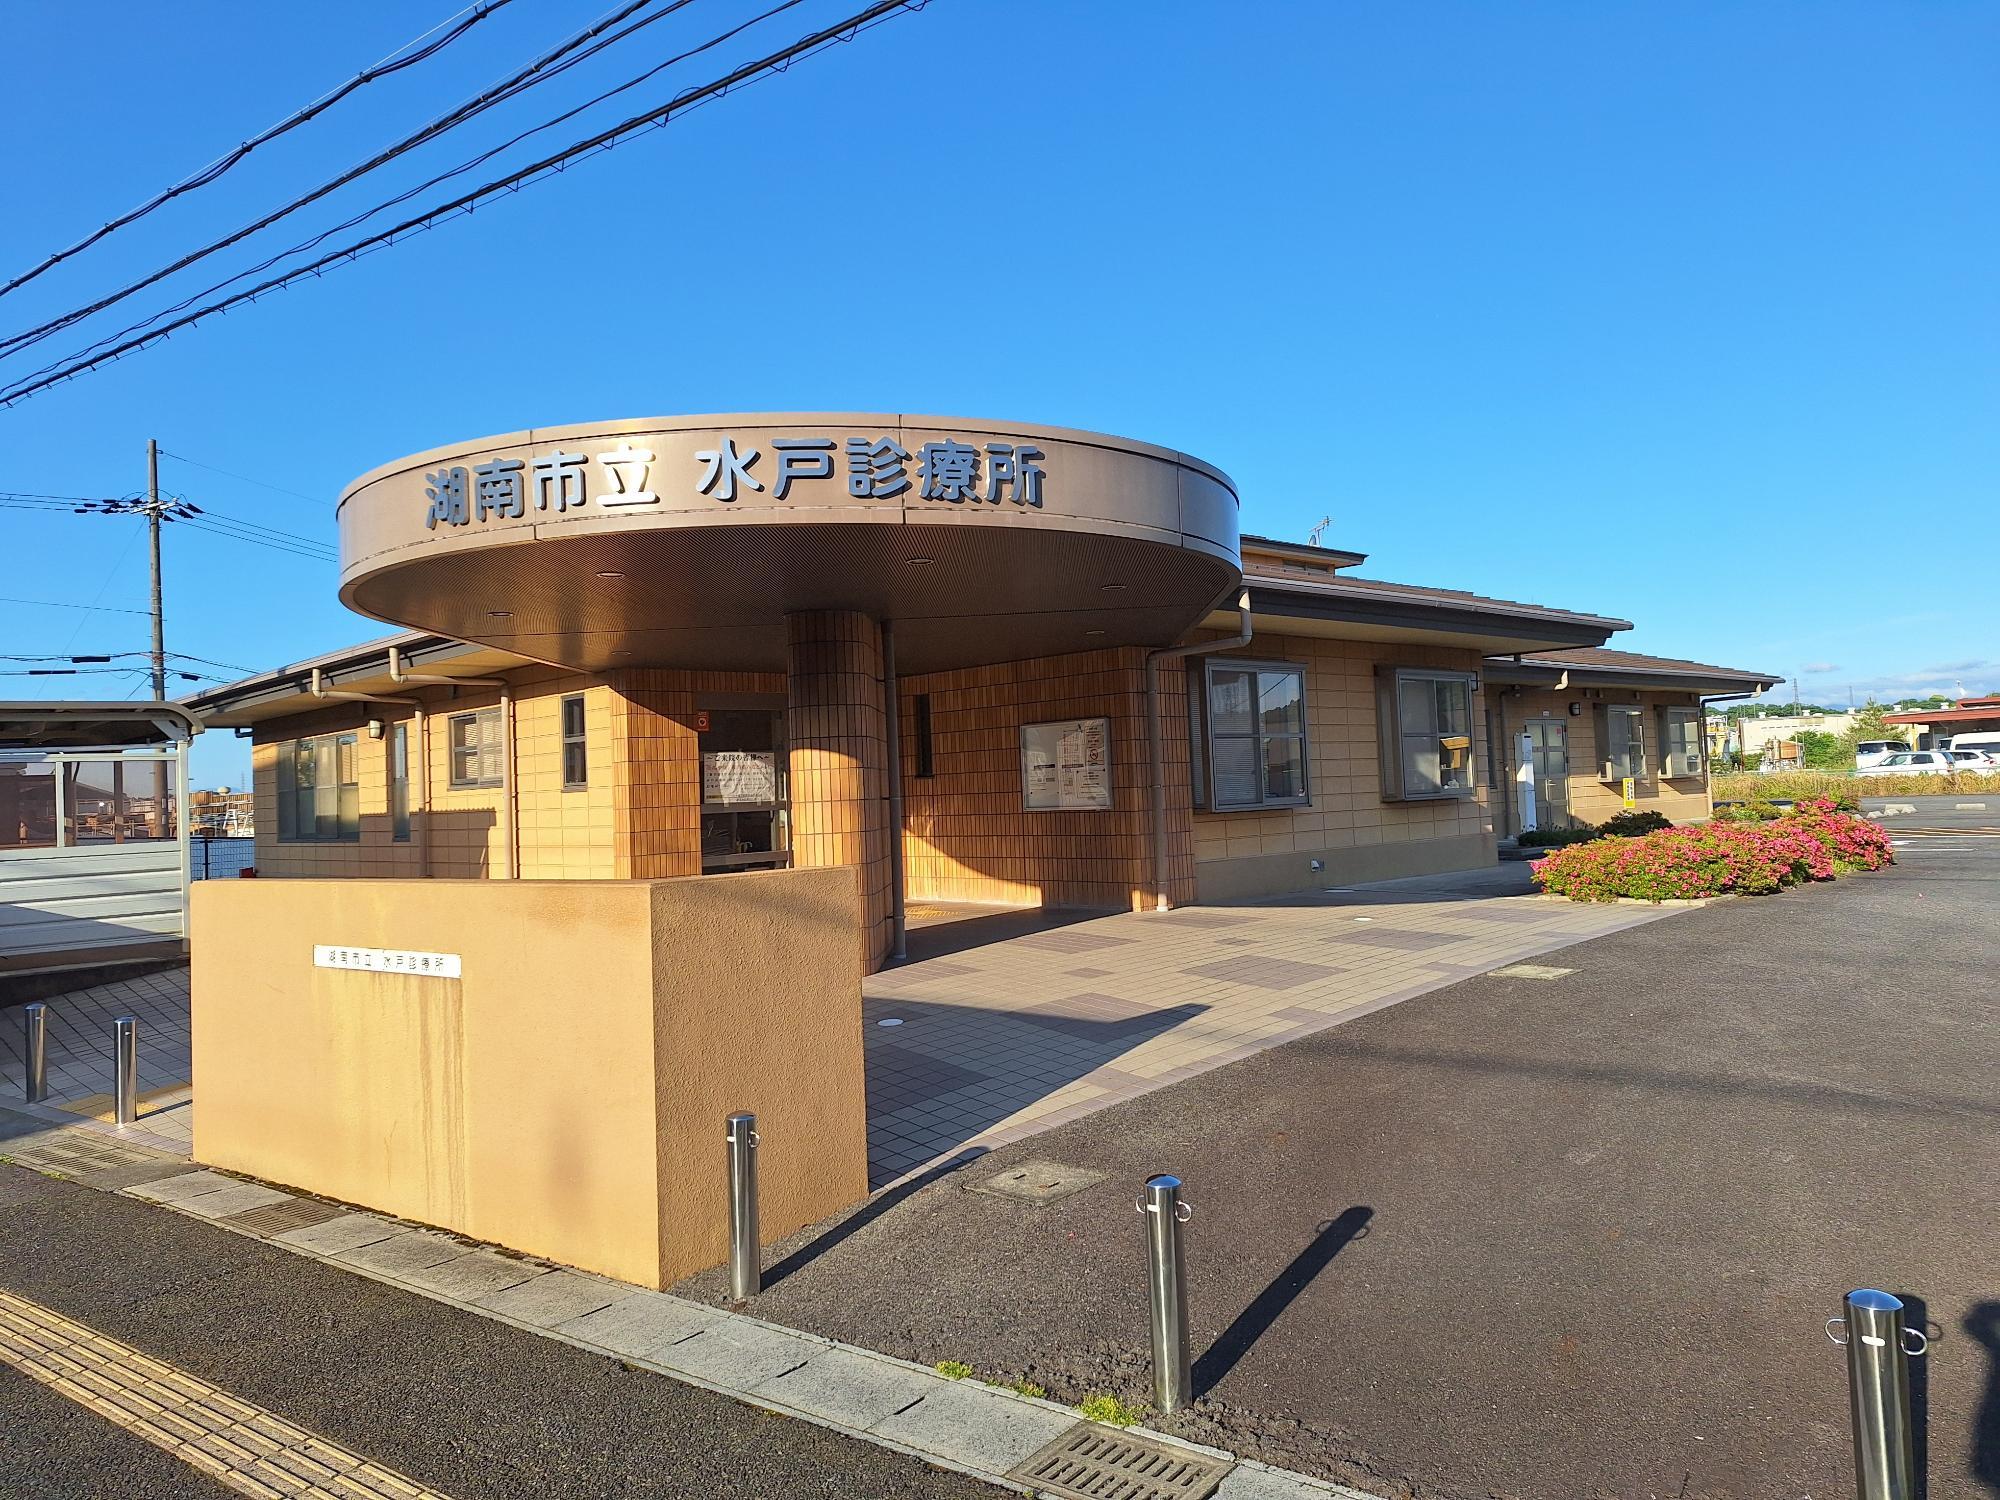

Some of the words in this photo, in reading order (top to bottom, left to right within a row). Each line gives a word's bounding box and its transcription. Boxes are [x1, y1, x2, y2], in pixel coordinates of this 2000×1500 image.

[423, 444, 660, 531] 湖南市立
[694, 436, 1046, 506] 水戸診療所
